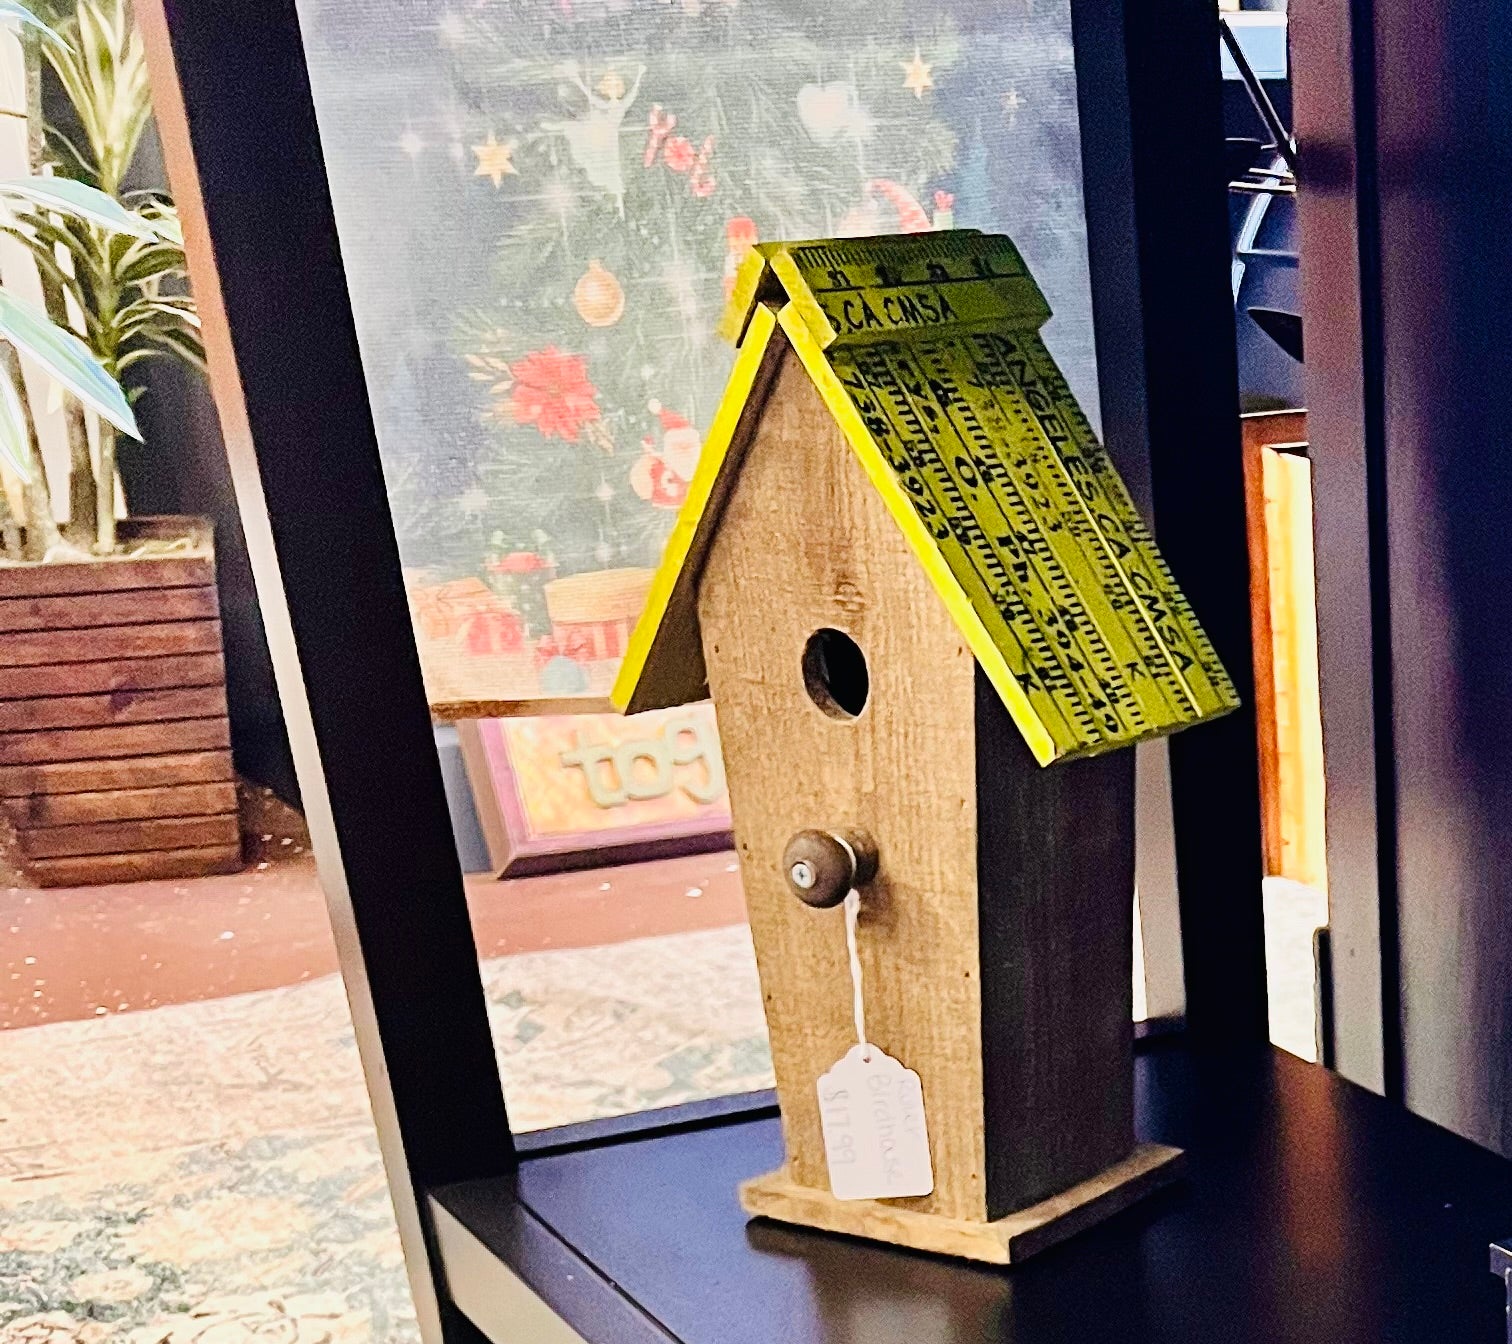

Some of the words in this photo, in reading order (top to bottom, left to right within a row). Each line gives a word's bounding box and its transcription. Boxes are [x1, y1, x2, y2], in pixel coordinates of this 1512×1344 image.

[843, 371, 951, 540] 738-3923
[1014, 671, 1041, 696] K
[1124, 662, 1146, 681] K
[1131, 569, 1195, 673] CMSA
